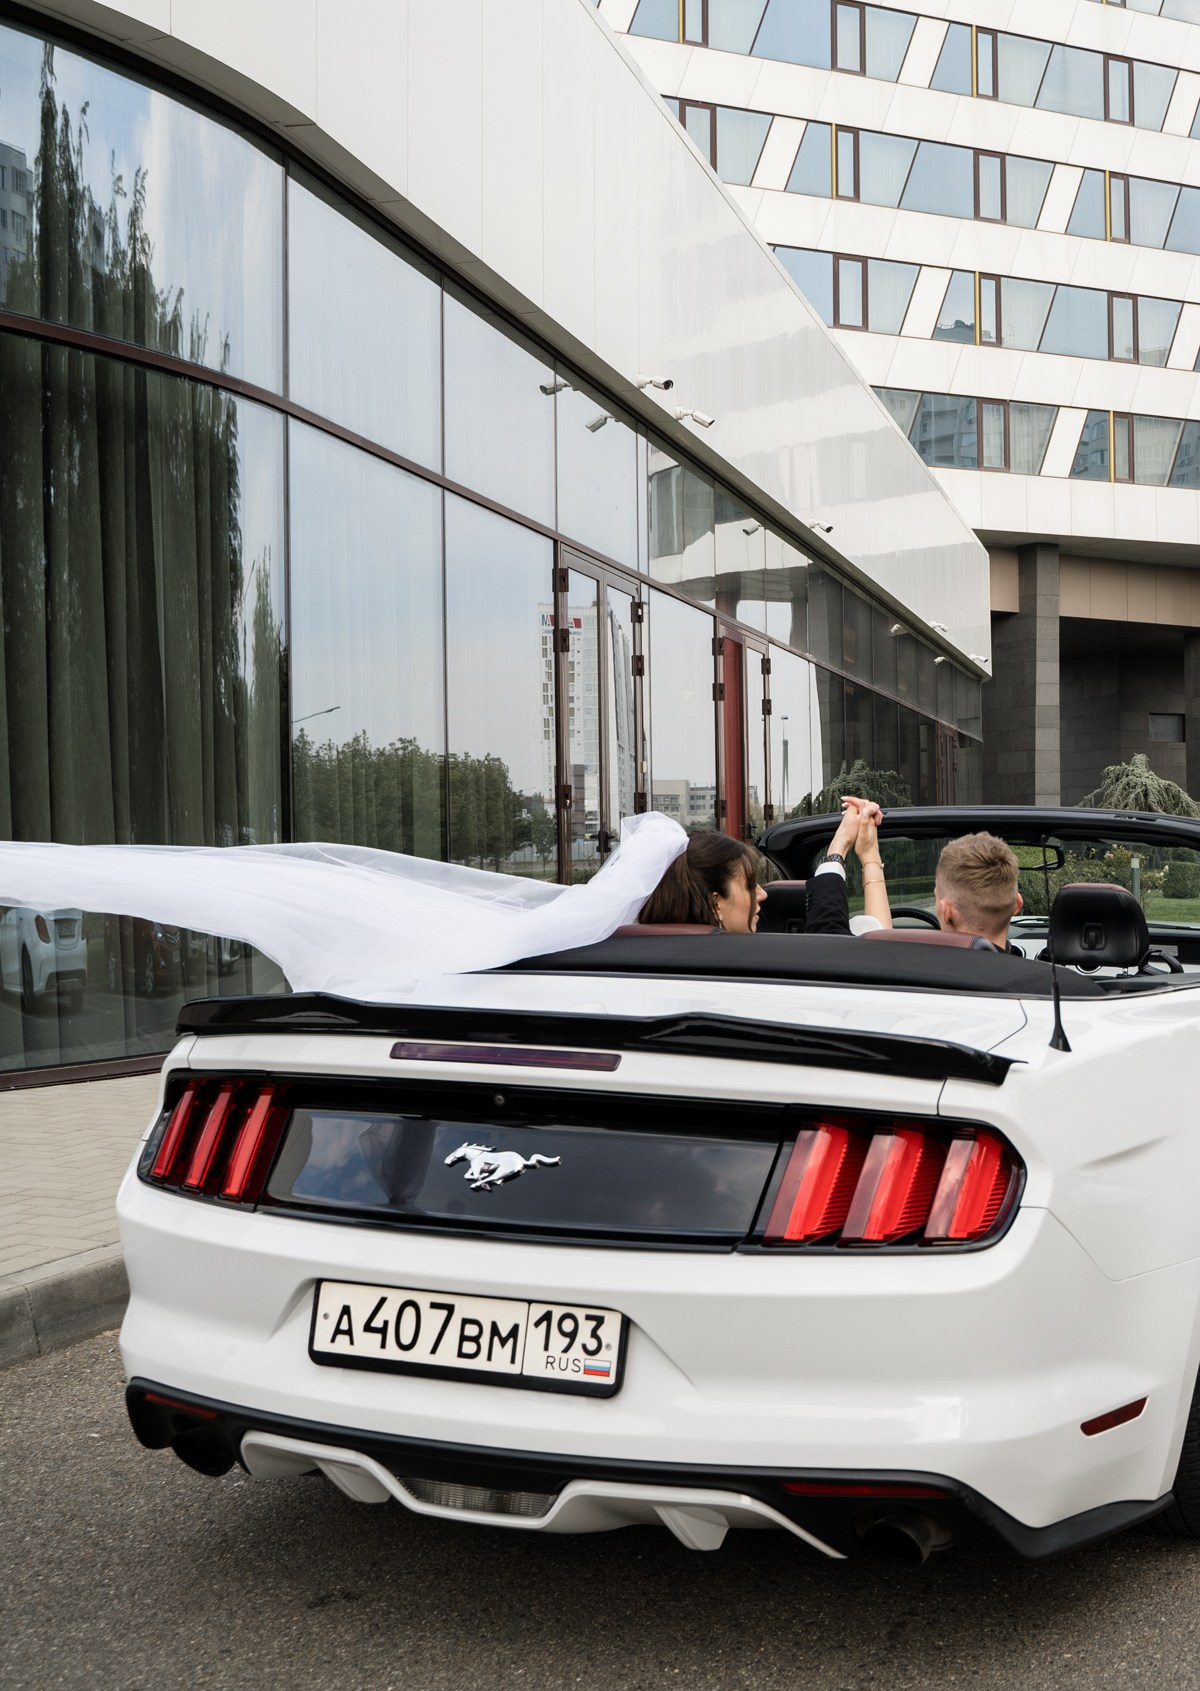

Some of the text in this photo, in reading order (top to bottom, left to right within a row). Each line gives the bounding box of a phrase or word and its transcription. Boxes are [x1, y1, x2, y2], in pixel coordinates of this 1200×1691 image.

[329, 1296, 606, 1365] А407ВМ 193
[545, 1355, 582, 1374] RUS
